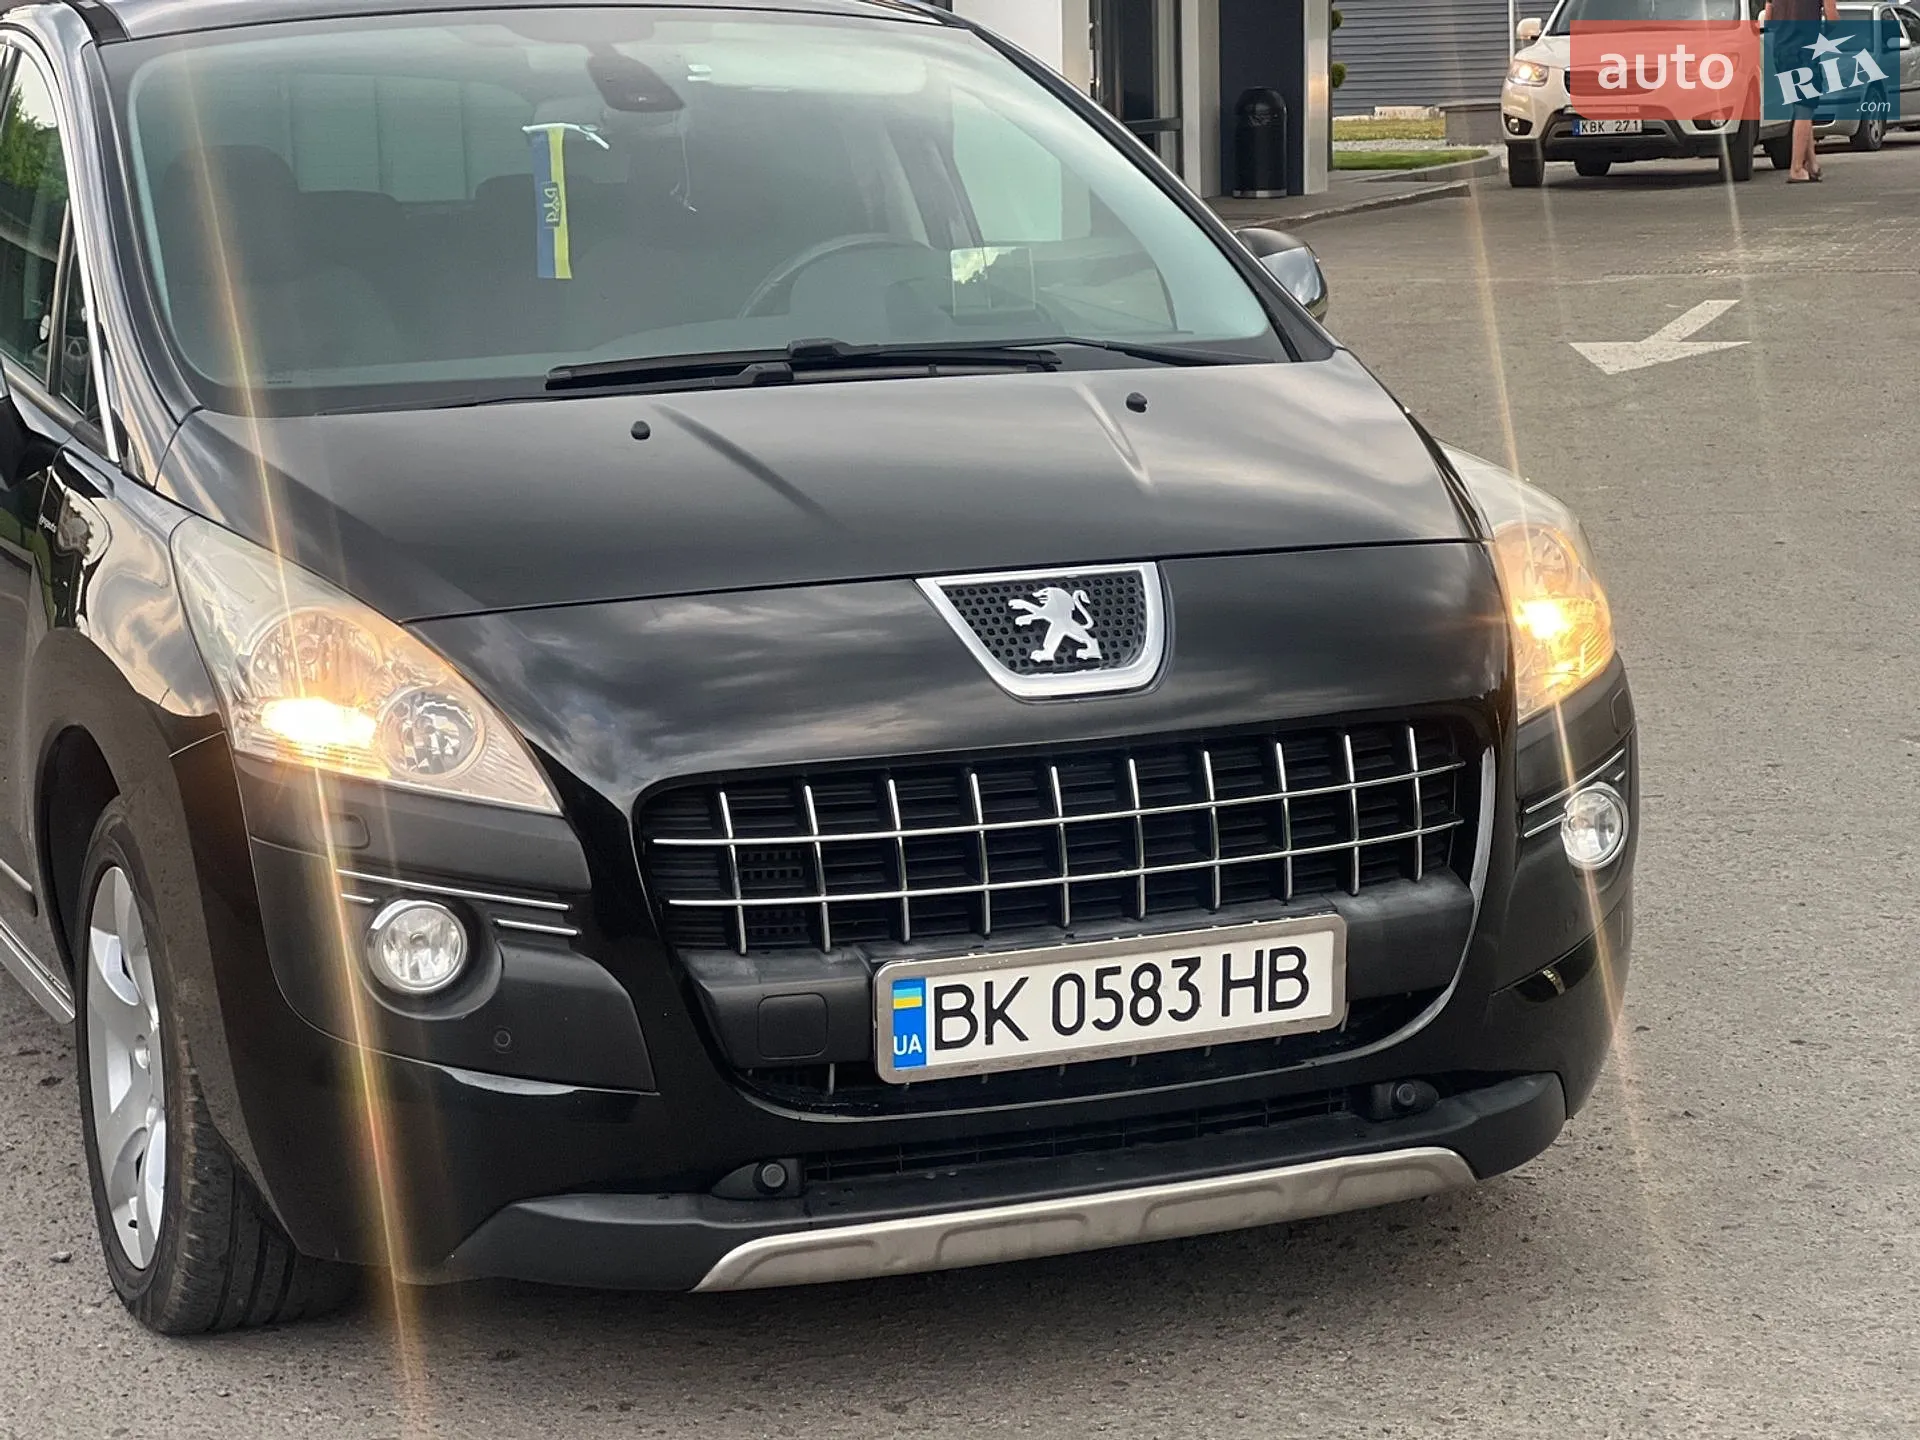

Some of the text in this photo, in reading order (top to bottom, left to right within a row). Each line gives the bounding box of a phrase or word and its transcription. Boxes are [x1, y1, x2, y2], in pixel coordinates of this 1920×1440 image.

[1581, 120, 1638, 133] KBK 271
[933, 946, 1310, 1051] BK 0583 HB
[893, 1034, 922, 1055] UA
